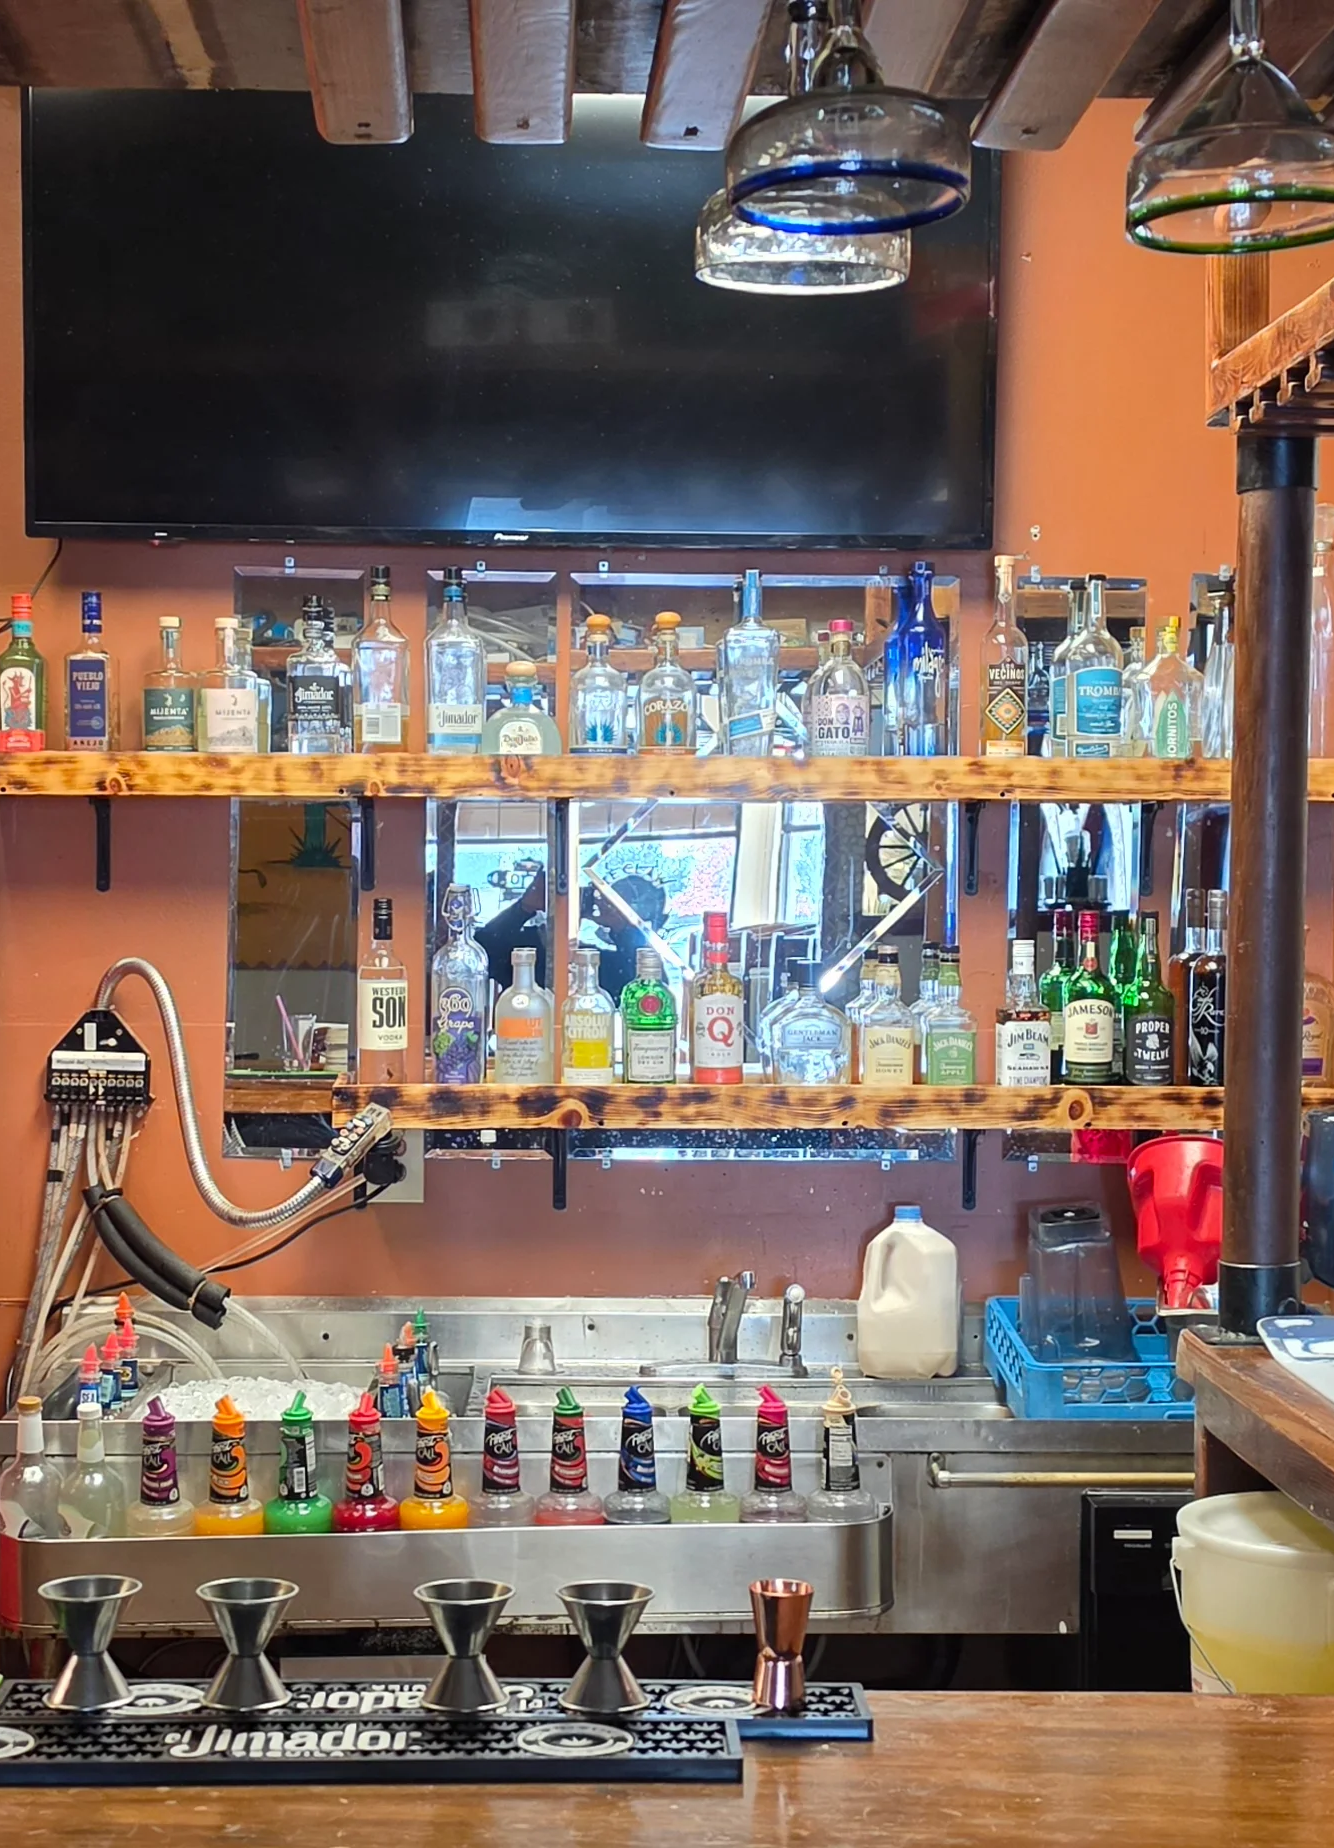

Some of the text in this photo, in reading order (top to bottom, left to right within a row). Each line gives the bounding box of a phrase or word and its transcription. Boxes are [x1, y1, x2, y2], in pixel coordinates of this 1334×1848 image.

[72, 671, 104, 681] PUEBLO
[988, 668, 1025, 680] VECINOS
[76, 681, 100, 691] VIEJO
[294, 686, 334, 704] Jimador
[150, 707, 188, 716] MIJENTA
[215, 708, 251, 716] MIJENTA
[438, 710, 478, 728] Jimador
[817, 717, 834, 726] DON
[817, 726, 851, 740] GATO
[439, 993, 471, 1017] 360
[706, 1006, 735, 1016] DON
[1064, 1003, 1111, 1019] JAMESON
[371, 996, 406, 1029] SON
[436, 1019, 475, 1035] Grape
[566, 1026, 607, 1040] CITRON
[706, 1016, 735, 1048] Q
[1135, 1020, 1170, 1035] PROPER
[377, 1034, 403, 1042] VODKA
[869, 1037, 885, 1050] JACK
[1007, 1028, 1049, 1048] JIM BEAM
[932, 1040, 948, 1052] JACK
[1135, 1045, 1170, 1061] TWELVE
[170, 1721, 408, 1759] Jimador
